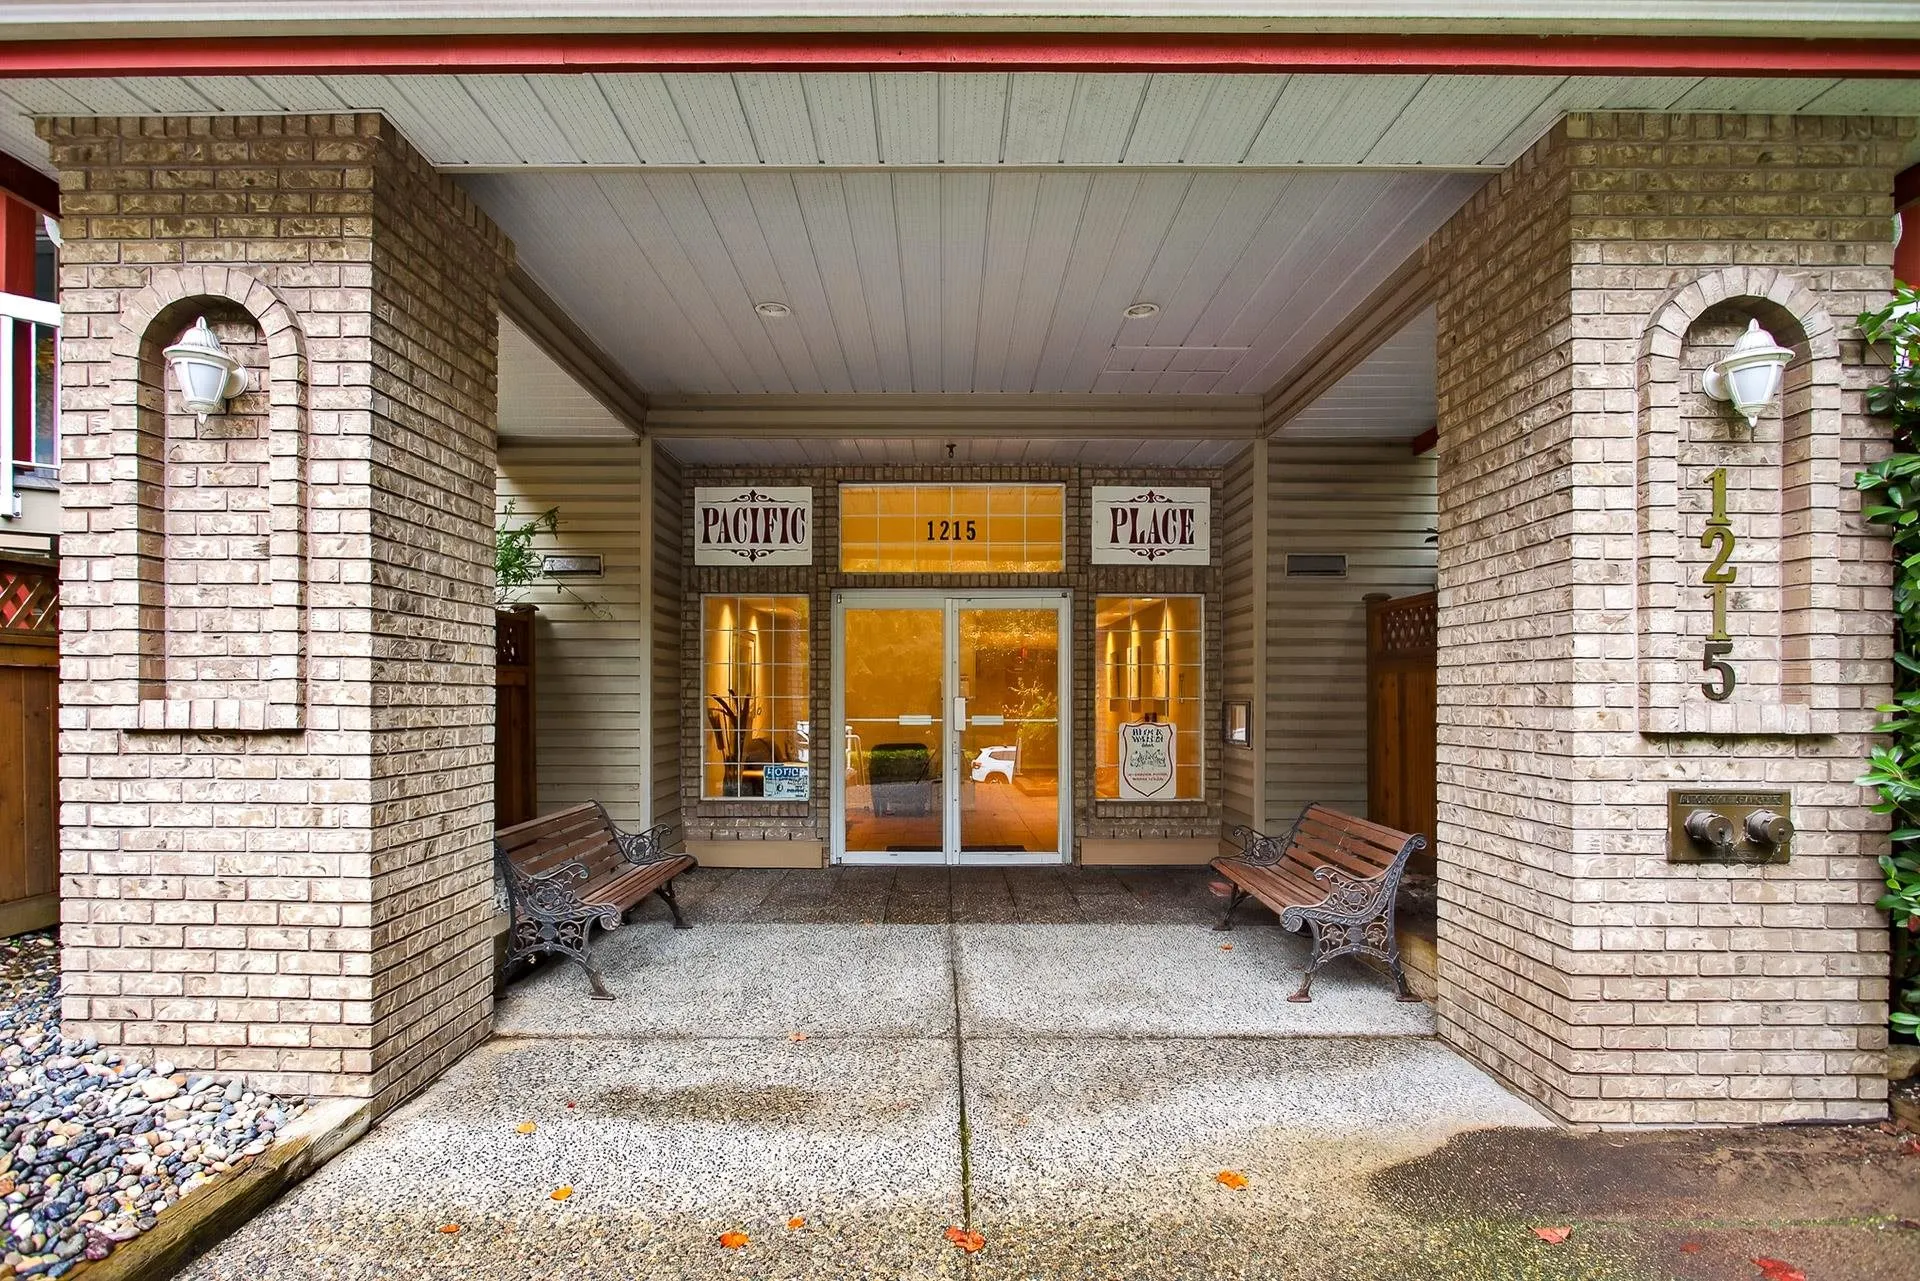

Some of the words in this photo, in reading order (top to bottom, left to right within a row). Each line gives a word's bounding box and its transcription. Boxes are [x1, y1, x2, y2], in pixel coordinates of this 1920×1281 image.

[701, 507, 806, 545] PACIFIC
[927, 520, 977, 541] 1215
[1110, 507, 1195, 545] PLACE
[1700, 467, 1738, 701] 1215
